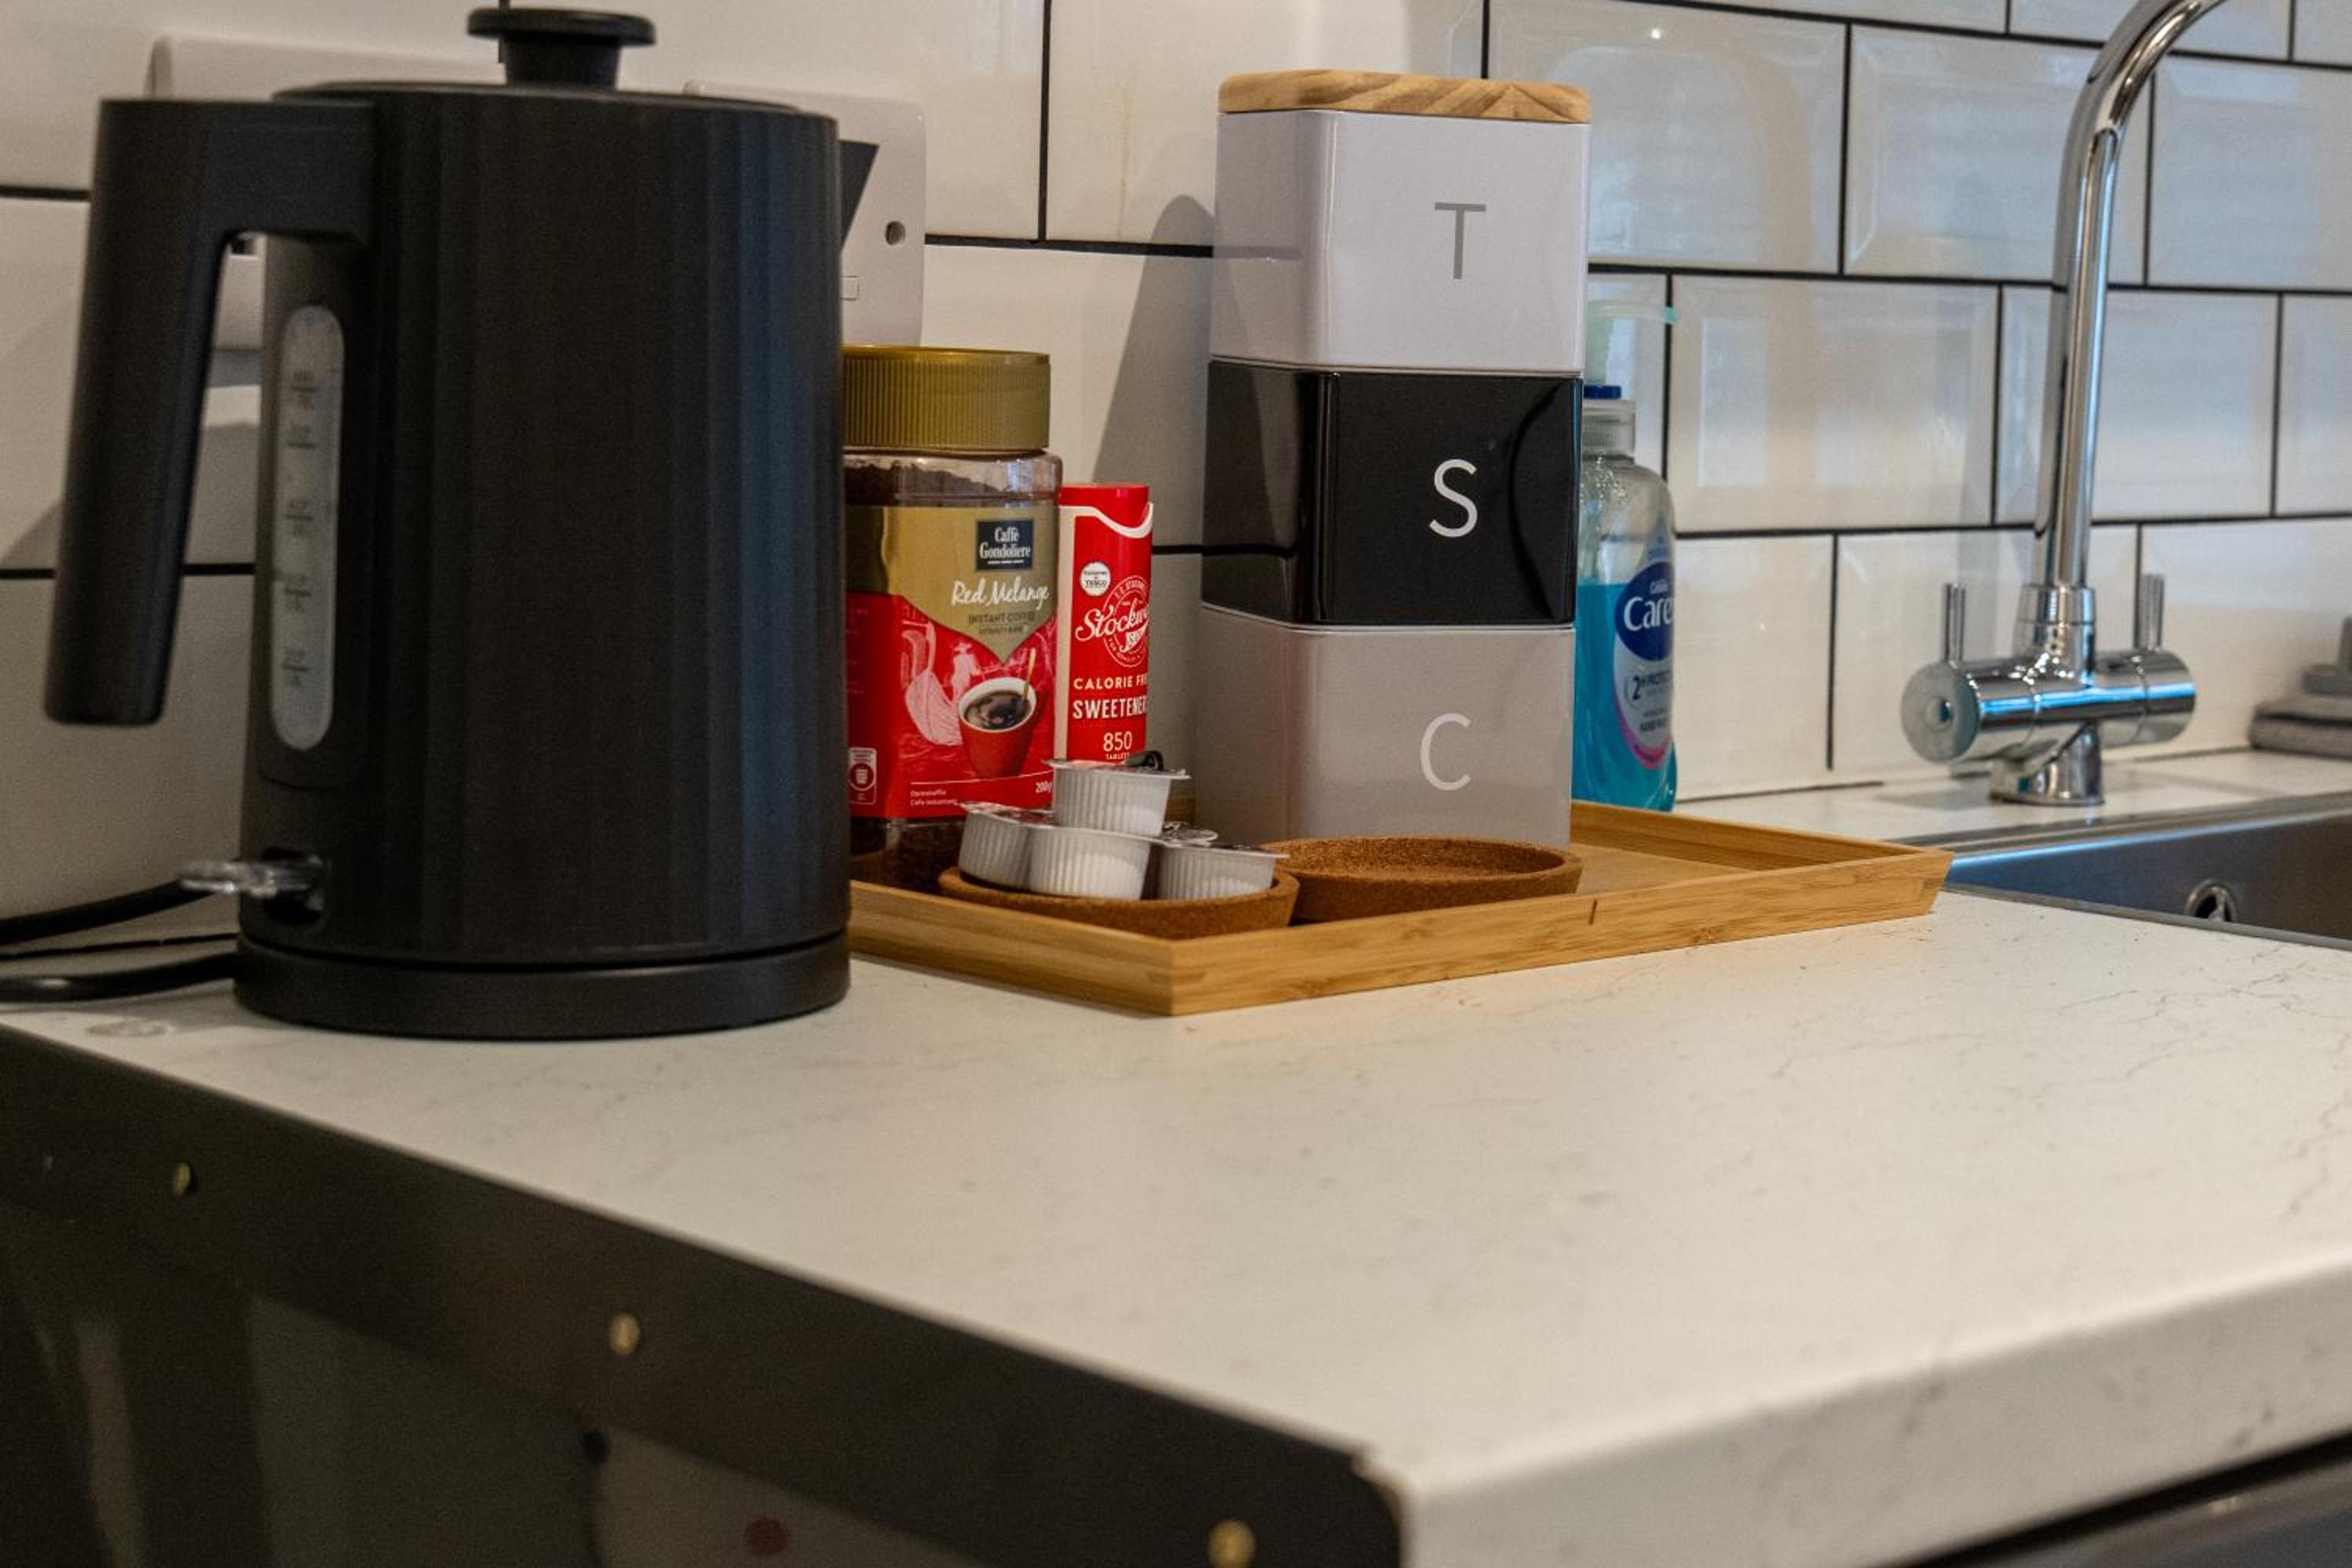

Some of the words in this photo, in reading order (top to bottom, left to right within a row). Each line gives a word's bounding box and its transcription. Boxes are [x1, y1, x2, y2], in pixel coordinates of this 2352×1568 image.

[1434, 202, 1486, 280] T
[1429, 459, 1478, 537] S
[951, 577, 986, 606] Red
[985, 576, 1051, 612] Melange
[1624, 596, 1674, 632] Care
[1073, 676, 1133, 690] CALORIE
[1103, 731, 1133, 753] 850
[1420, 713, 1471, 791] C
